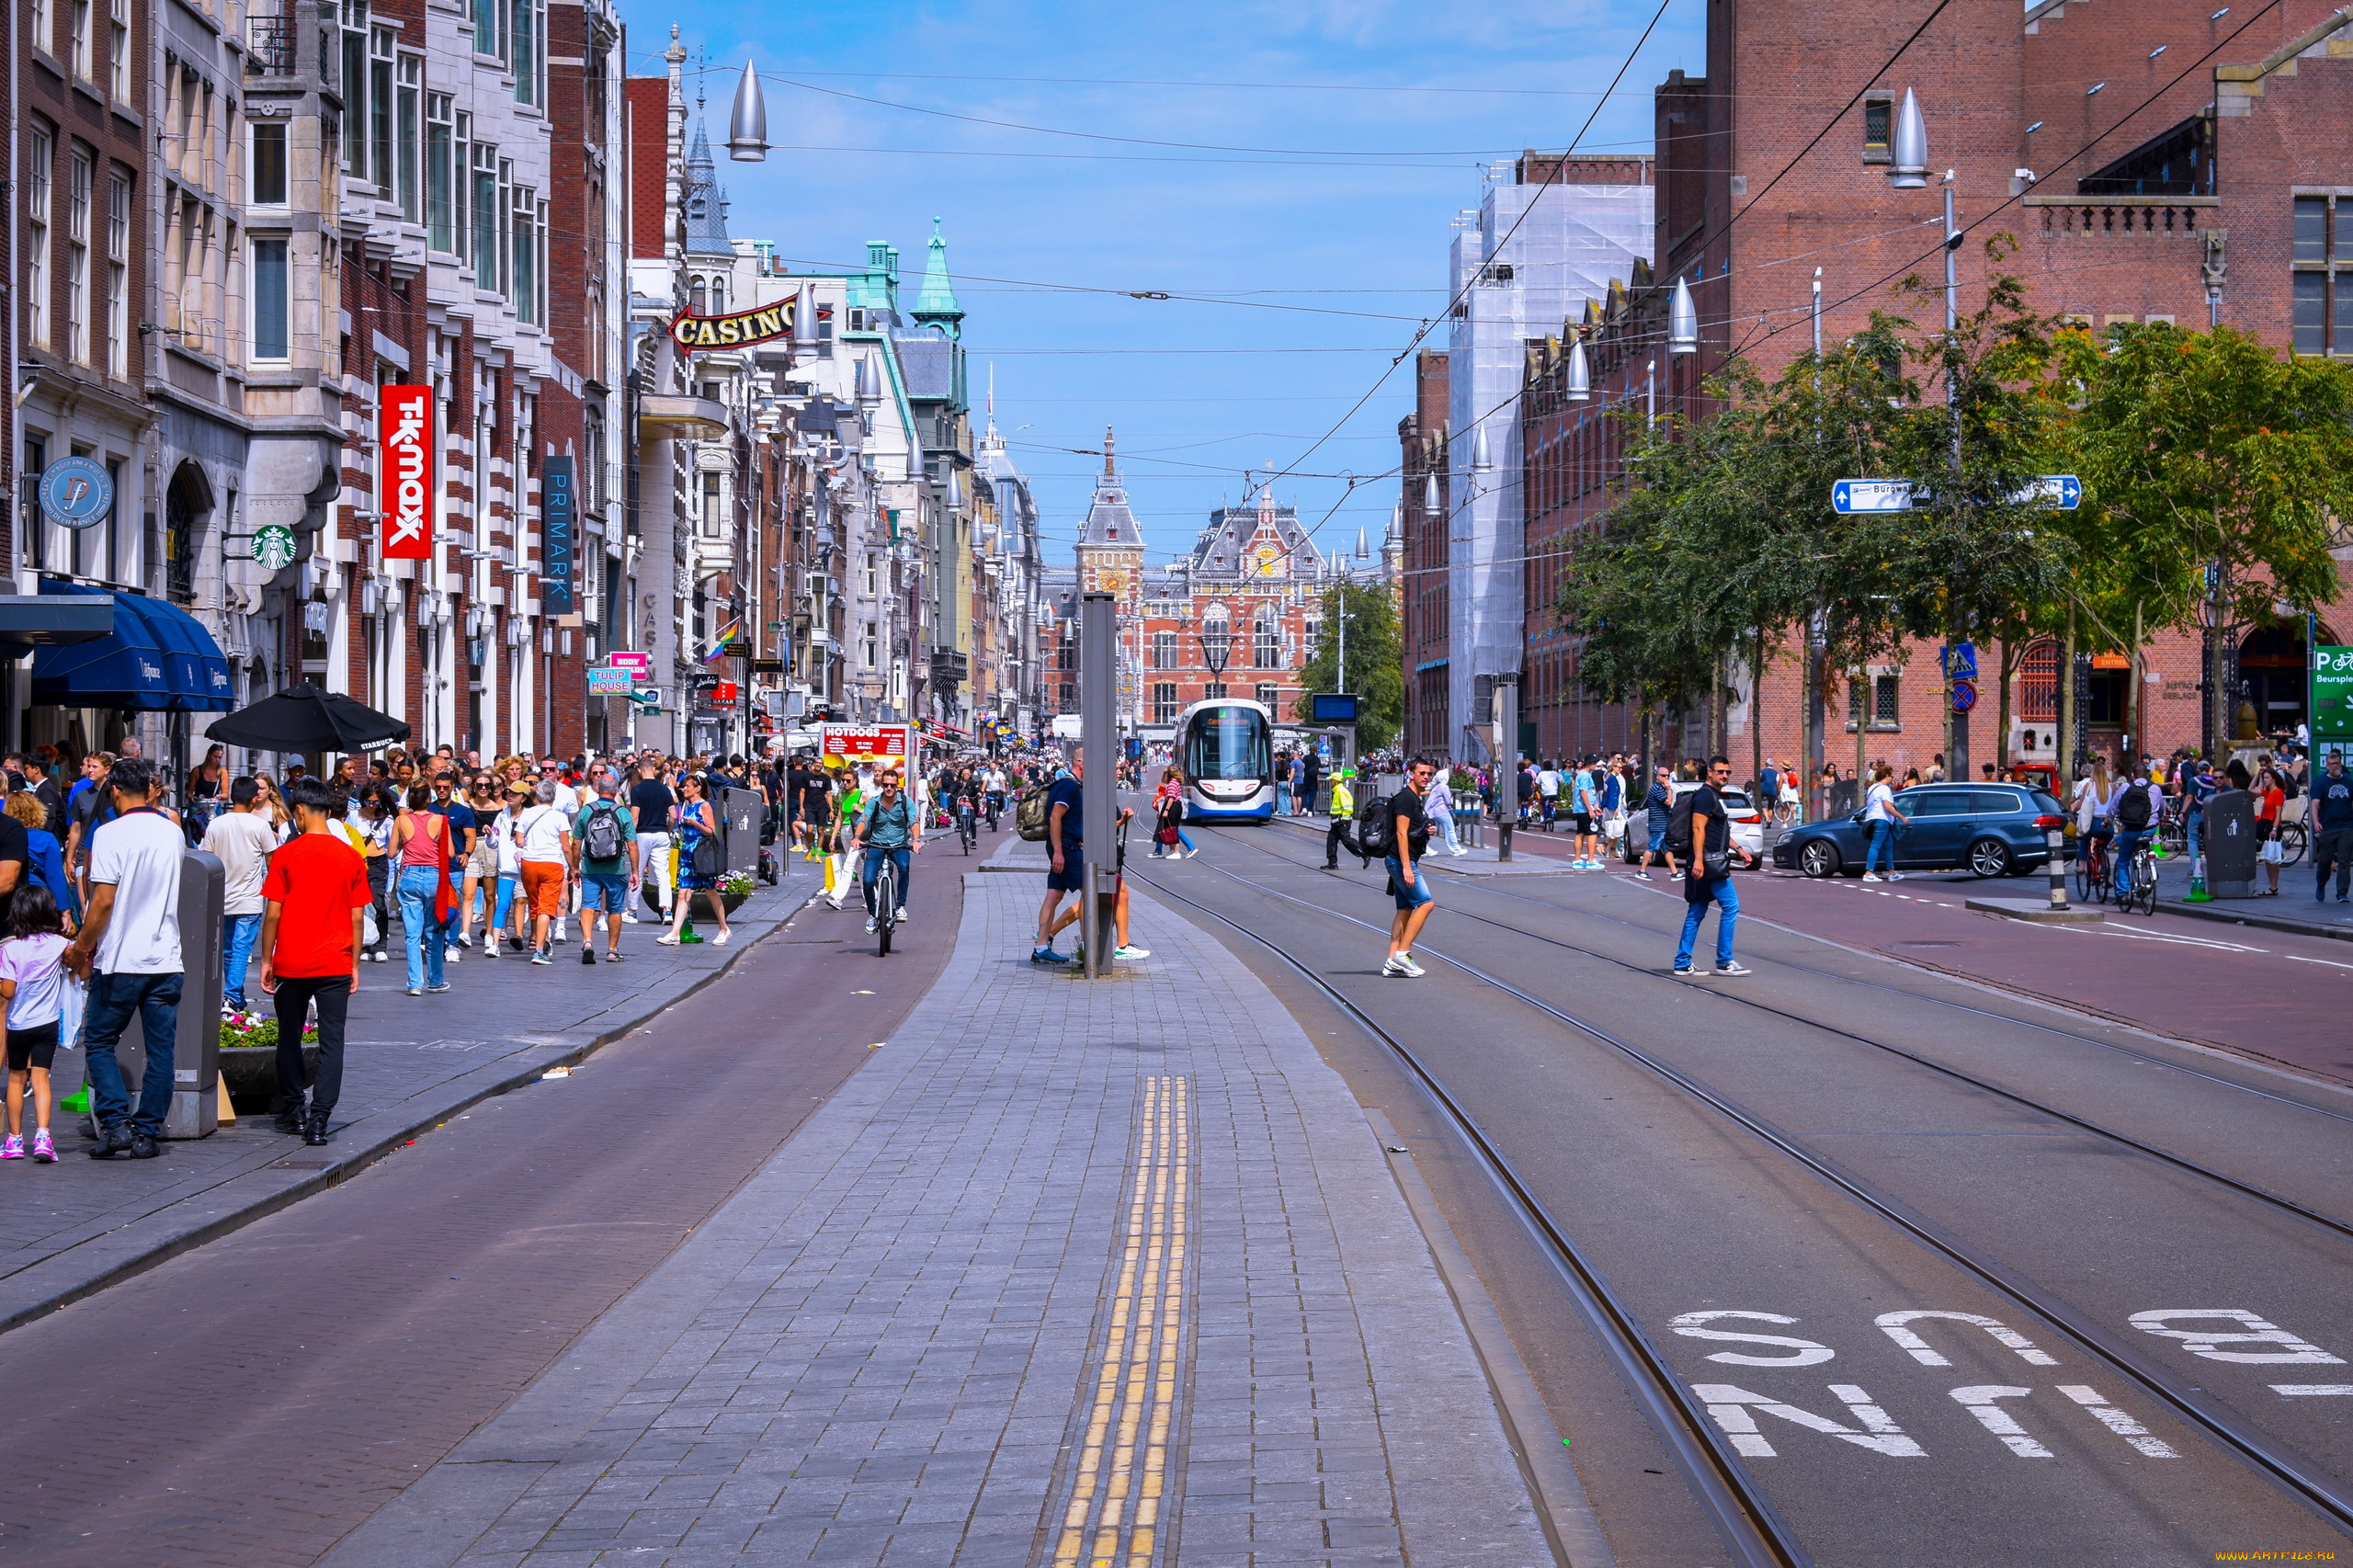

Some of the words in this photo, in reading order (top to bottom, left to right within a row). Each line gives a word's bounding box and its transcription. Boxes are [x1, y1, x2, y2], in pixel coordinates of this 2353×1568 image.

[675, 301, 795, 345] CASINO
[551, 474, 569, 599] PRIMARK
[595, 672, 625, 680] TULIP
[593, 682, 629, 690] HOUSE
[826, 727, 881, 737] HOTDOGS
[360, 738, 393, 750] STARBUCK
